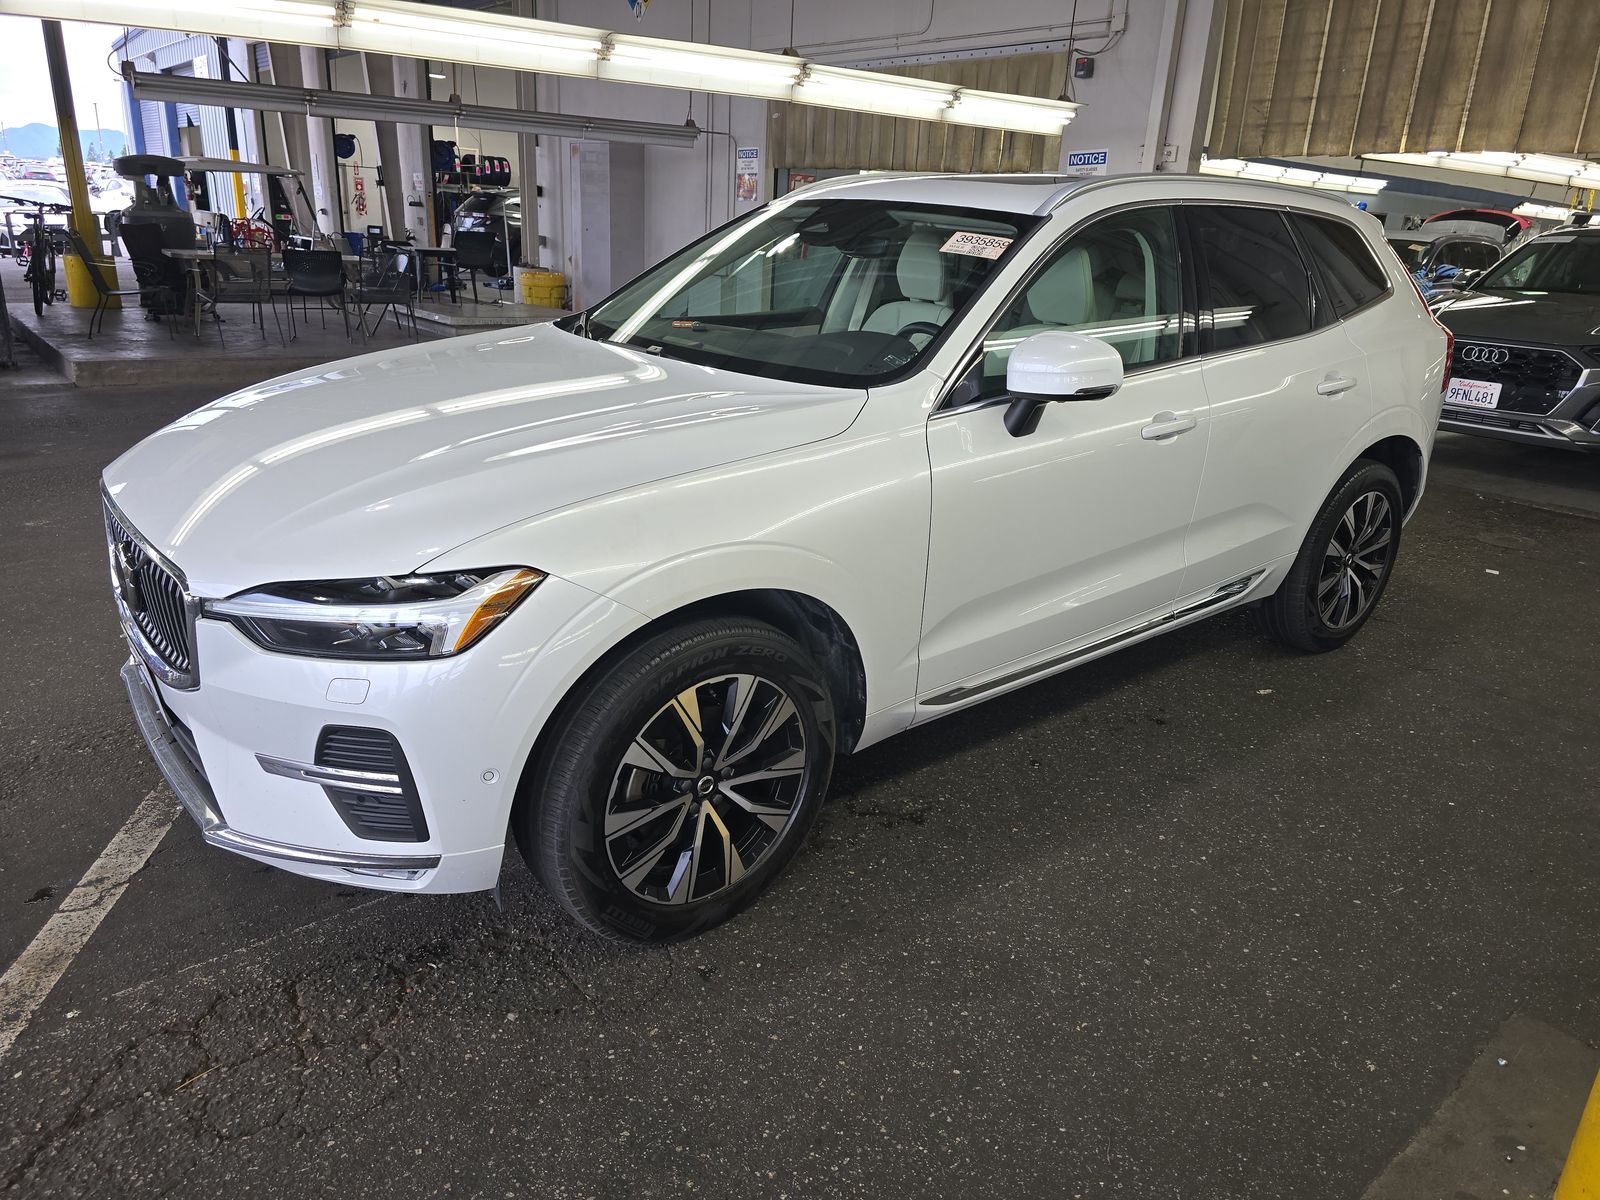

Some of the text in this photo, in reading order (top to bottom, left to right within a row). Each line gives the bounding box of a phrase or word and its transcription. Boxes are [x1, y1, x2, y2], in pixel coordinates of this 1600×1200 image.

[738, 150, 757, 158] NOTICE
[1070, 153, 1105, 165] NOTICE
[956, 234, 1011, 249] 3935859
[1459, 380, 1488, 389] California
[1448, 387, 1494, 405] 9FNL481
[734, 645, 788, 663] ZERO
